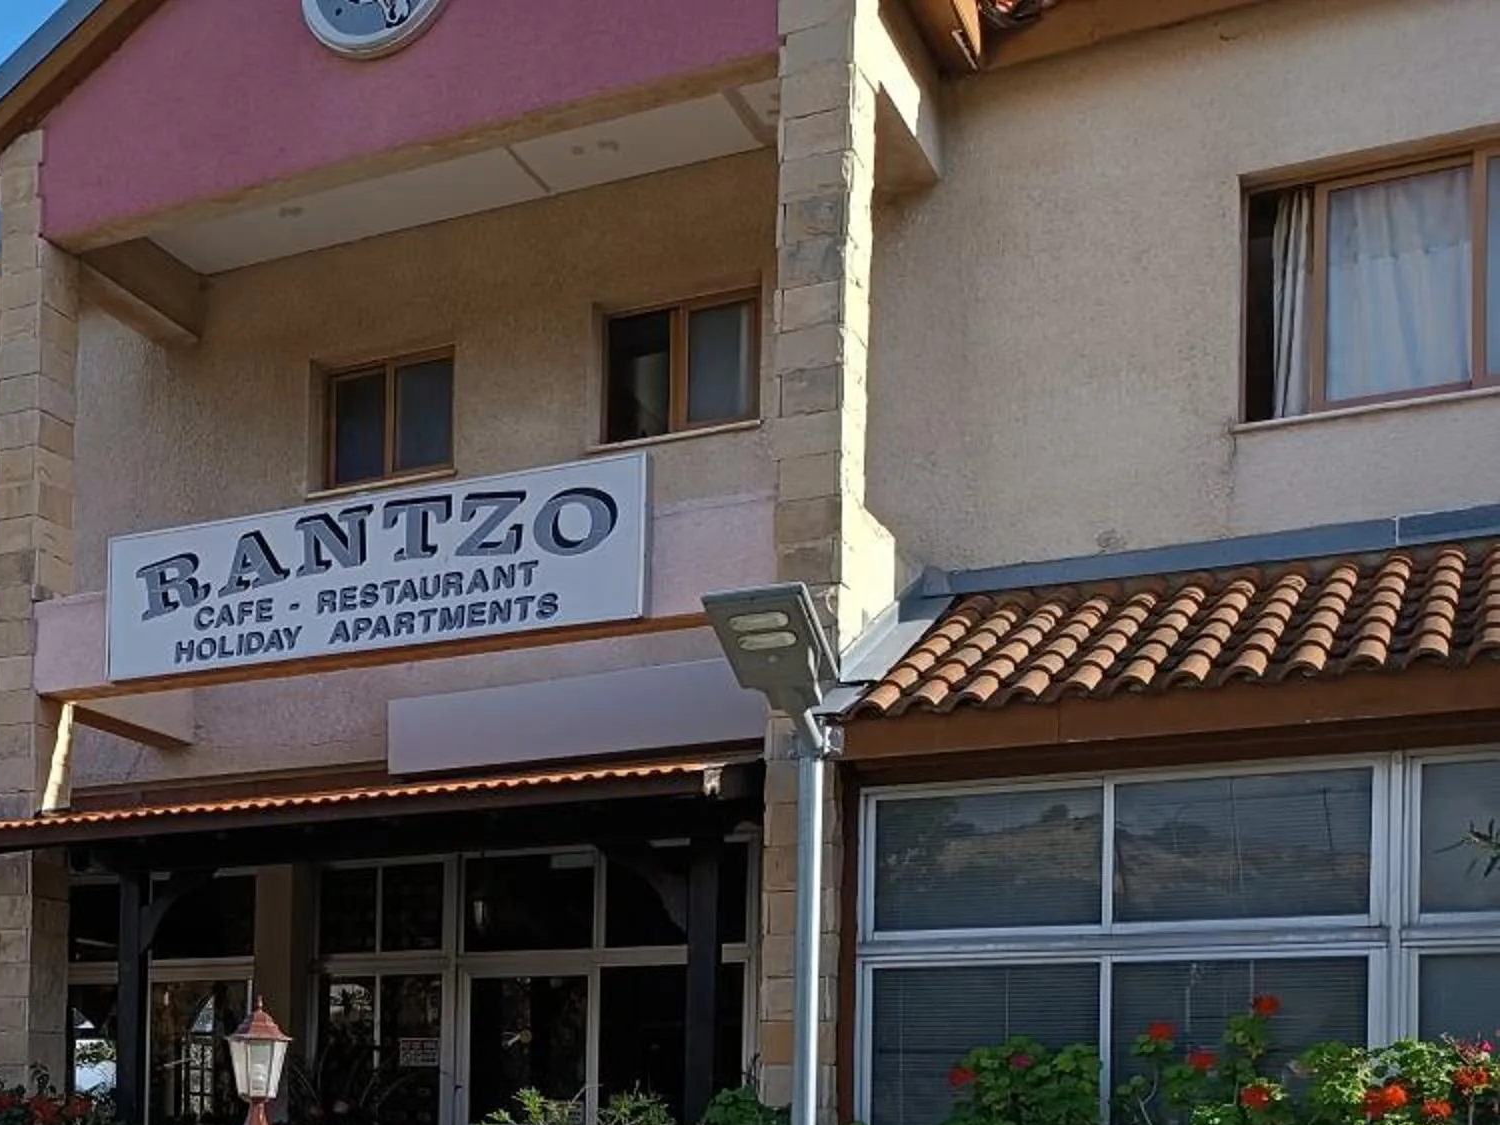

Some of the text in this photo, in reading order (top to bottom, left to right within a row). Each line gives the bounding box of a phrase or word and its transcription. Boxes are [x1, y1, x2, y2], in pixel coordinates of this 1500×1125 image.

[136, 487, 617, 621] RANTZO
[174, 593, 559, 663] HOLIDAY APARTMENTS
[194, 598, 273, 630] CAFE
[317, 560, 539, 615] RESTAURANT
